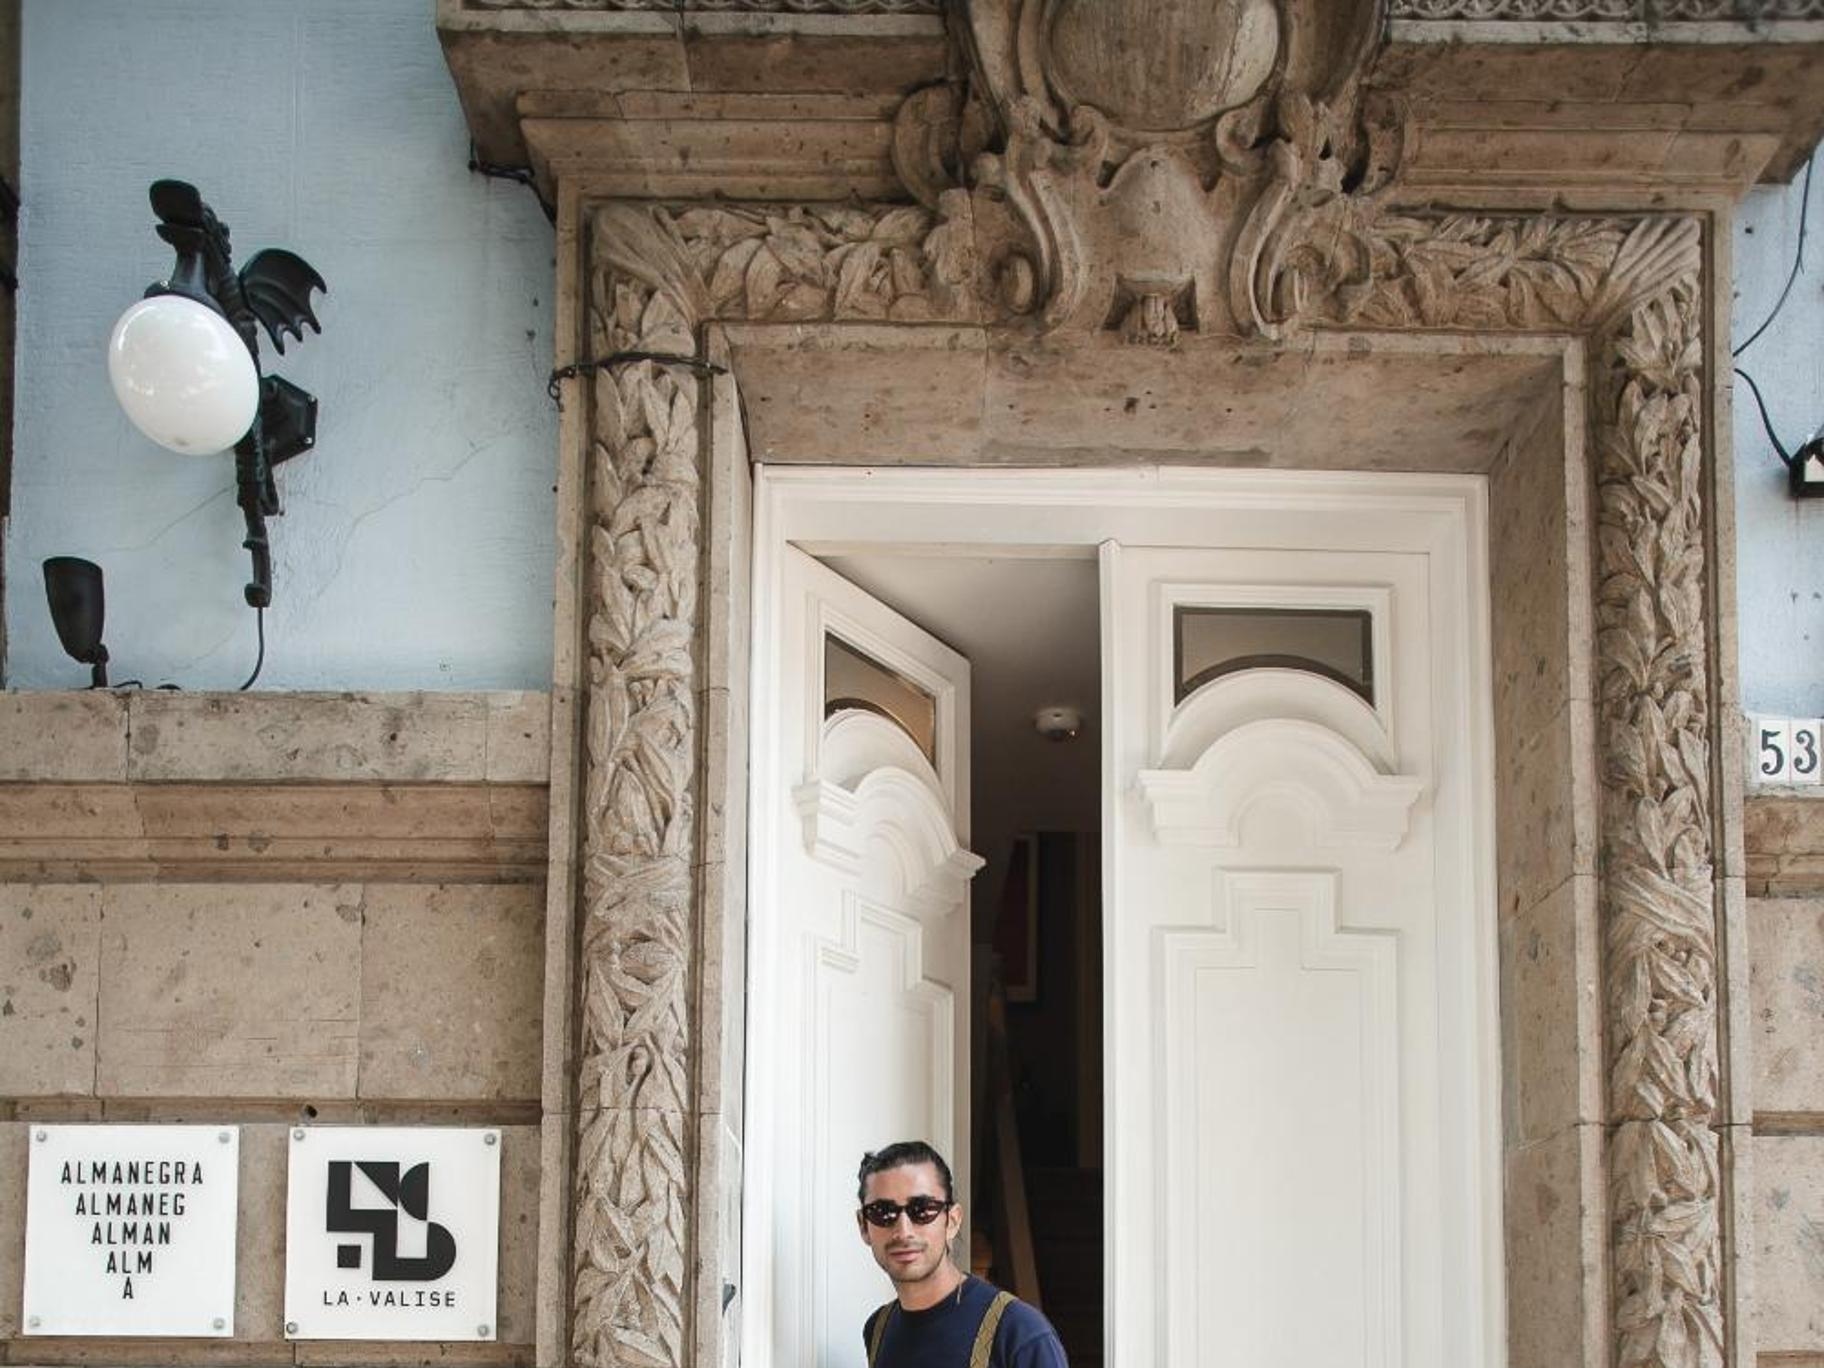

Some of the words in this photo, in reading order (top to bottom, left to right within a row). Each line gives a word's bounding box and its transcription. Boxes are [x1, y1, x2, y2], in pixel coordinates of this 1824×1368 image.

[1761, 729, 1818, 776] 53
[61, 1161, 203, 1185] ALMANEGRA
[75, 1192, 185, 1216] ALMANEG
[91, 1221, 171, 1245] ALMAN
[106, 1250, 153, 1274] ALM
[122, 1276, 134, 1300] A
